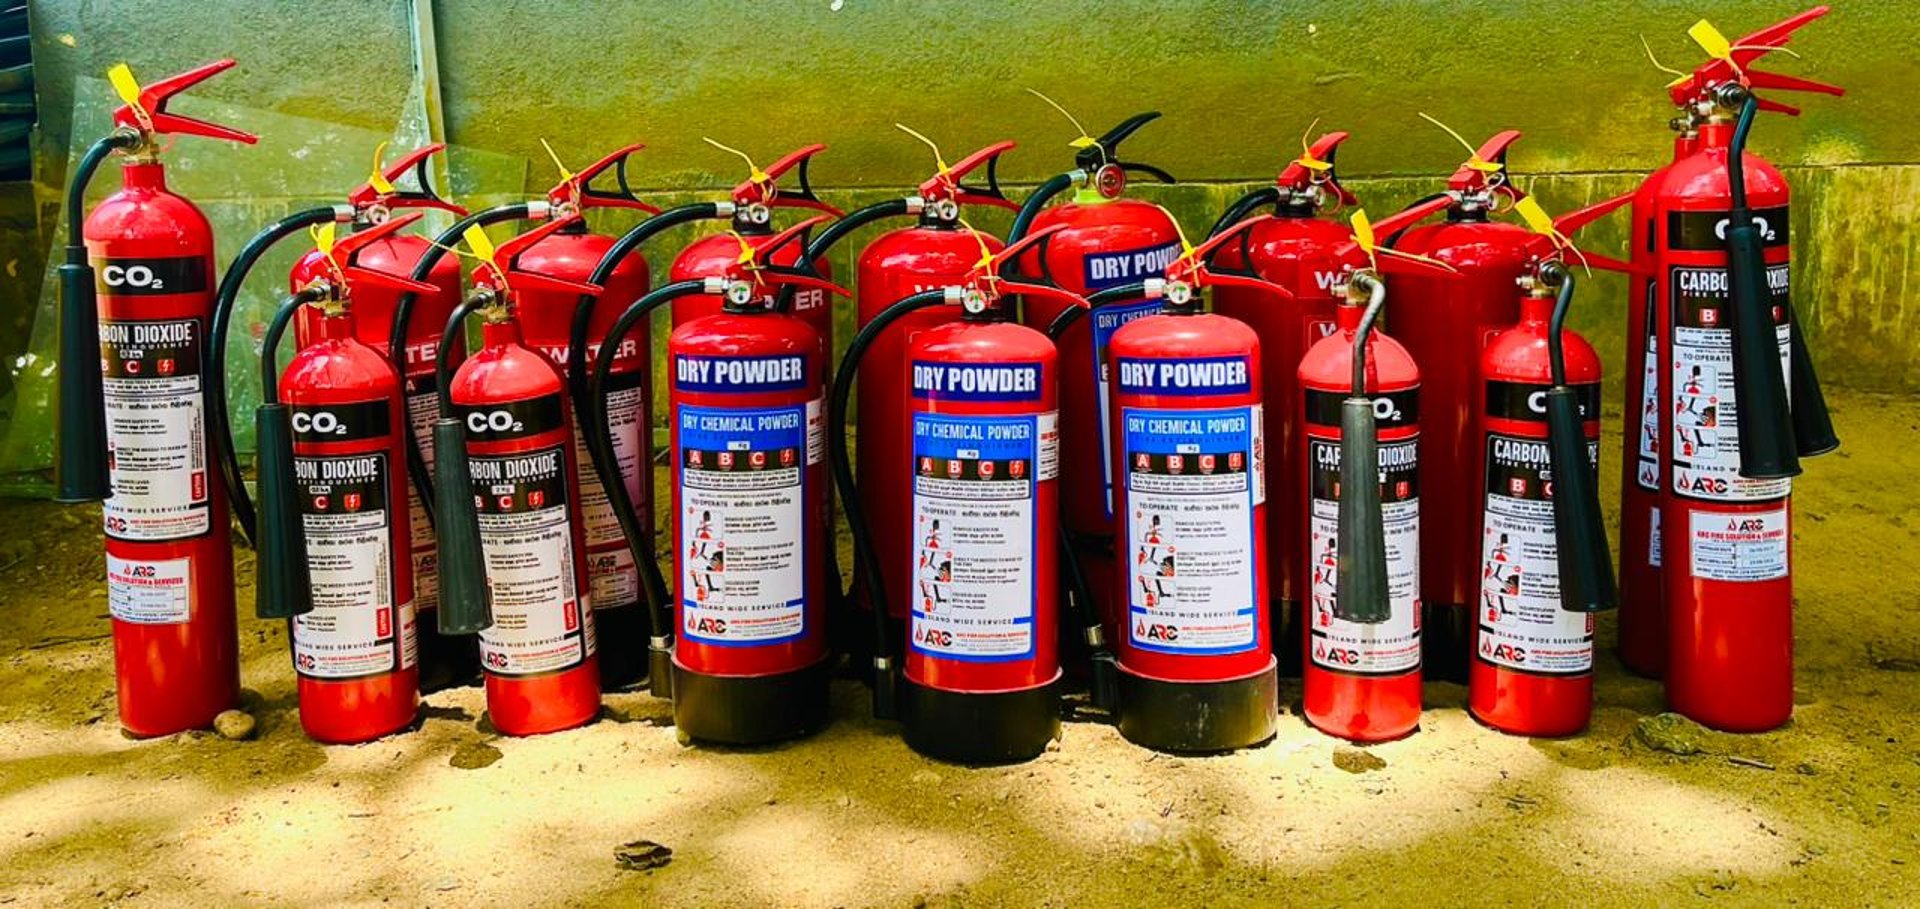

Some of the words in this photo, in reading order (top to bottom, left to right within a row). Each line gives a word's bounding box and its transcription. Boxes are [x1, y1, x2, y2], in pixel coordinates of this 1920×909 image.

[1090, 255, 1130, 280] DRY
[1680, 271, 1729, 292] CARBO
[1098, 315, 1118, 328] DRY
[1703, 309, 1715, 322] B
[100, 324, 129, 343] BON
[134, 323, 192, 343] DIOXIDE
[126, 360, 138, 373] C
[1694, 354, 1730, 362] OPERATE
[677, 358, 711, 384] DRY
[714, 357, 802, 384] POWDER
[1121, 362, 1156, 387] DRY
[1160, 361, 1246, 387] POWDER
[914, 366, 944, 391] DRY
[948, 367, 1036, 393] POWDER
[1373, 397, 1402, 420] O2
[683, 414, 698, 430] DRY
[701, 416, 755, 432] CHEMICAL
[758, 413, 799, 431] POWDER
[916, 421, 930, 436] DRY
[932, 423, 984, 440] CHEMICAL
[988, 424, 1030, 440] POWDER
[1129, 418, 1145, 433] DRY
[1149, 419, 1204, 435] CHEMICAL
[1207, 417, 1246, 434] POWDER
[690, 450, 702, 465] A
[720, 452, 732, 465] B
[751, 452, 765, 466] C
[1378, 443, 1417, 467] DIOXIDE
[1494, 440, 1551, 464] CARBON
[295, 461, 318, 480] BON
[322, 457, 378, 479] DIOXIDE
[469, 461, 500, 480] RBON
[505, 453, 558, 479] DIOXIDE
[921, 457, 932, 471] A
[949, 460, 960, 473] B
[980, 460, 993, 474] C
[1137, 455, 1148, 468] A
[1169, 456, 1180, 469] B
[1202, 456, 1214, 469] C
[1511, 478, 1525, 491] B
[1692, 478, 1729, 493] ARC
[315, 495, 327, 509] C
[500, 495, 512, 508] C
[1739, 519, 1764, 532] ARC
[132, 566, 156, 577] ARC
[697, 617, 727, 634] ARC
[1147, 624, 1178, 641] ARC
[924, 628, 952, 647] ARC
[1327, 648, 1359, 665] ARC
[1493, 644, 1526, 662] ARC
